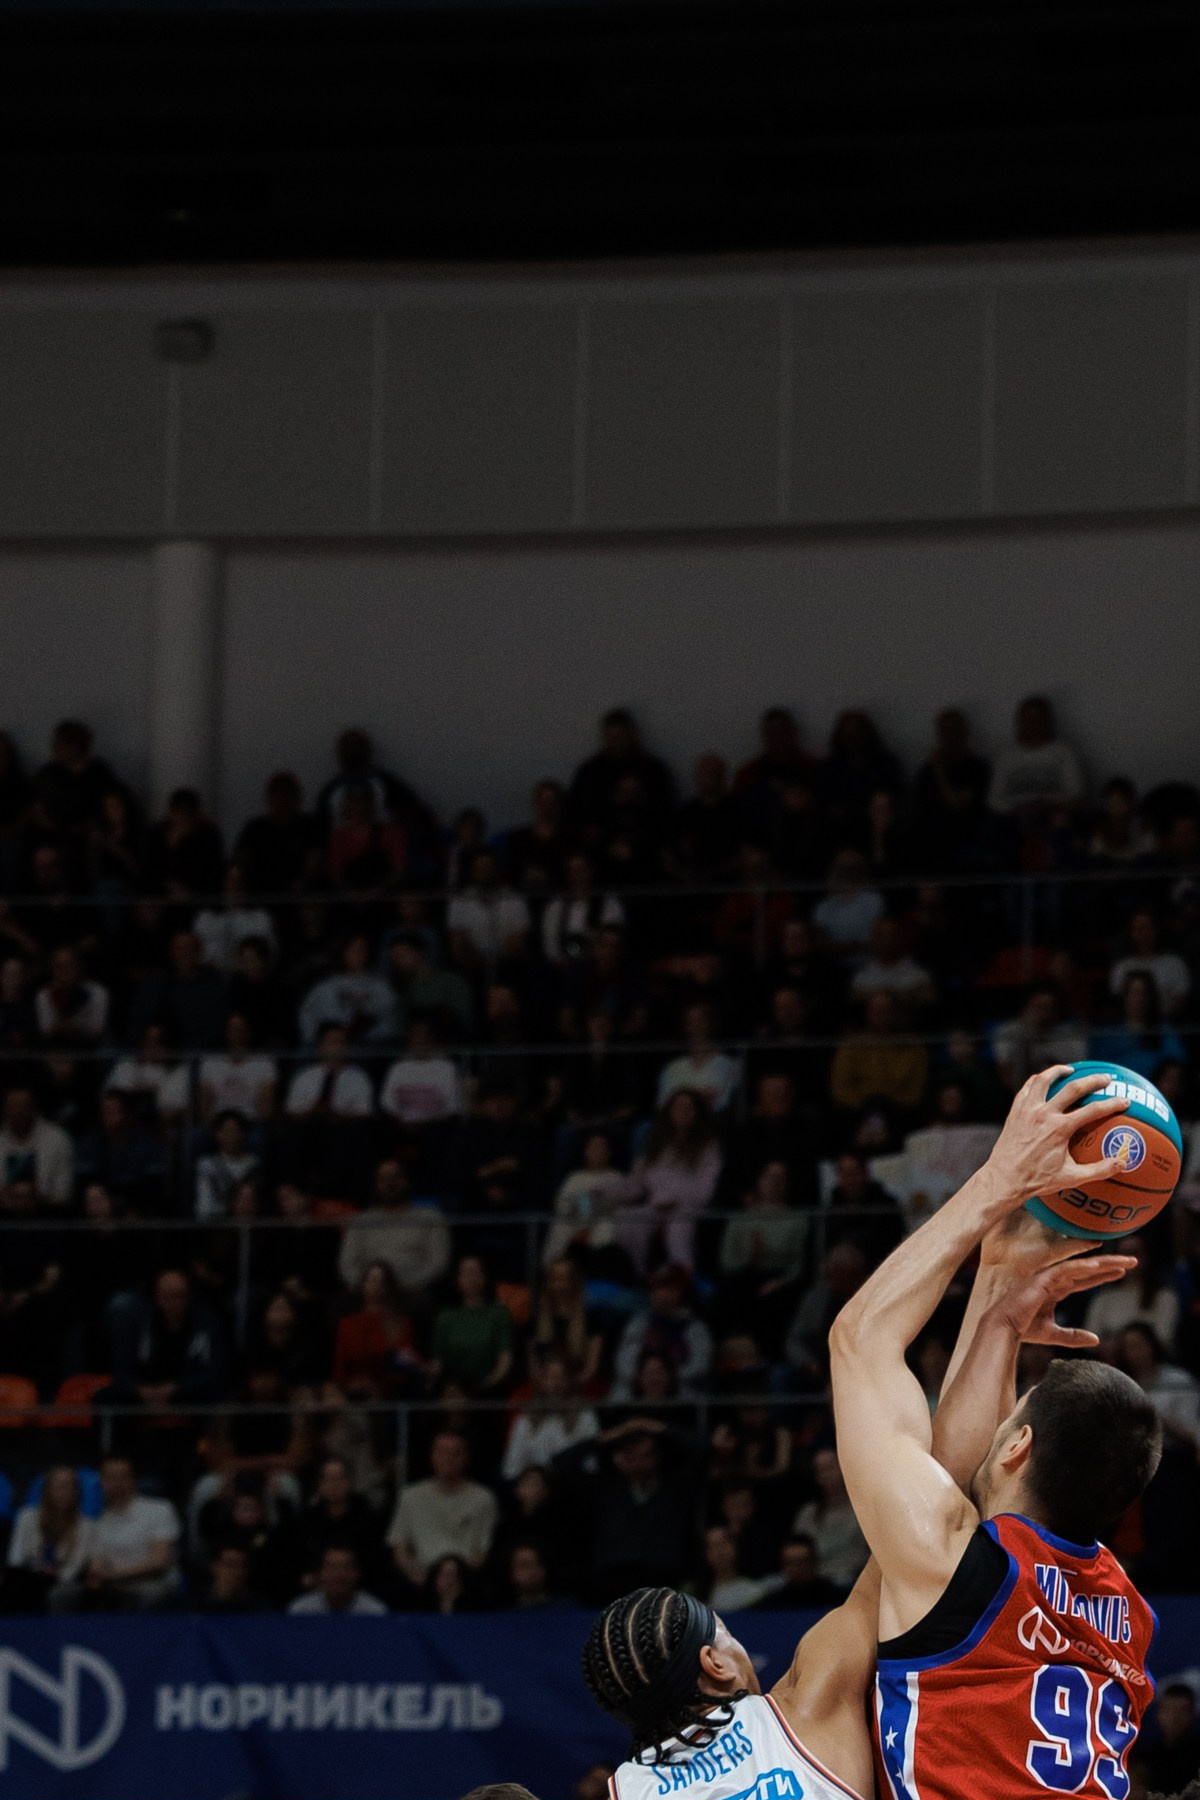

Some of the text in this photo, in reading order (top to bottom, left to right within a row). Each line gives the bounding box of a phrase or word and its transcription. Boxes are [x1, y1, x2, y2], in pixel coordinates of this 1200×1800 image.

[1092, 1080, 1170, 1123] SIBU
[155, 1683, 504, 1731] НОРНИКЕЛЬ
[652, 1720, 753, 1795] SANDERS
